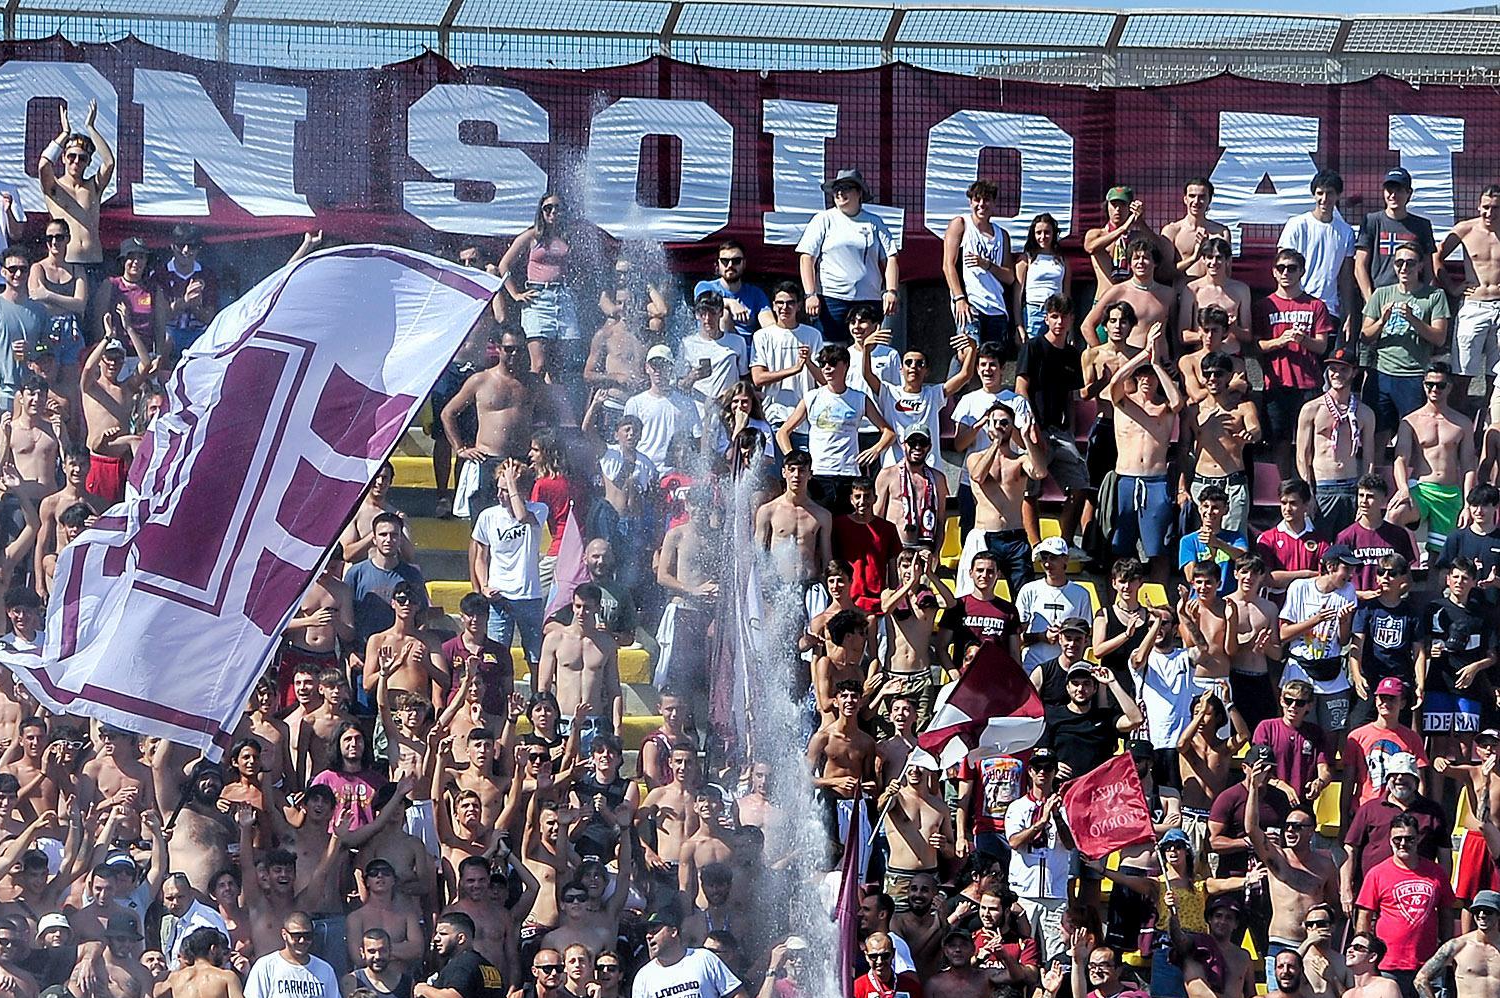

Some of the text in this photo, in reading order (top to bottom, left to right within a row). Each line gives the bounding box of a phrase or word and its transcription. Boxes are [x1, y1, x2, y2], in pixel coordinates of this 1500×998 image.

[402, 84, 1075, 254] SOLO
[496, 525, 526, 541] VANS
[1378, 629, 1399, 646] NFL
